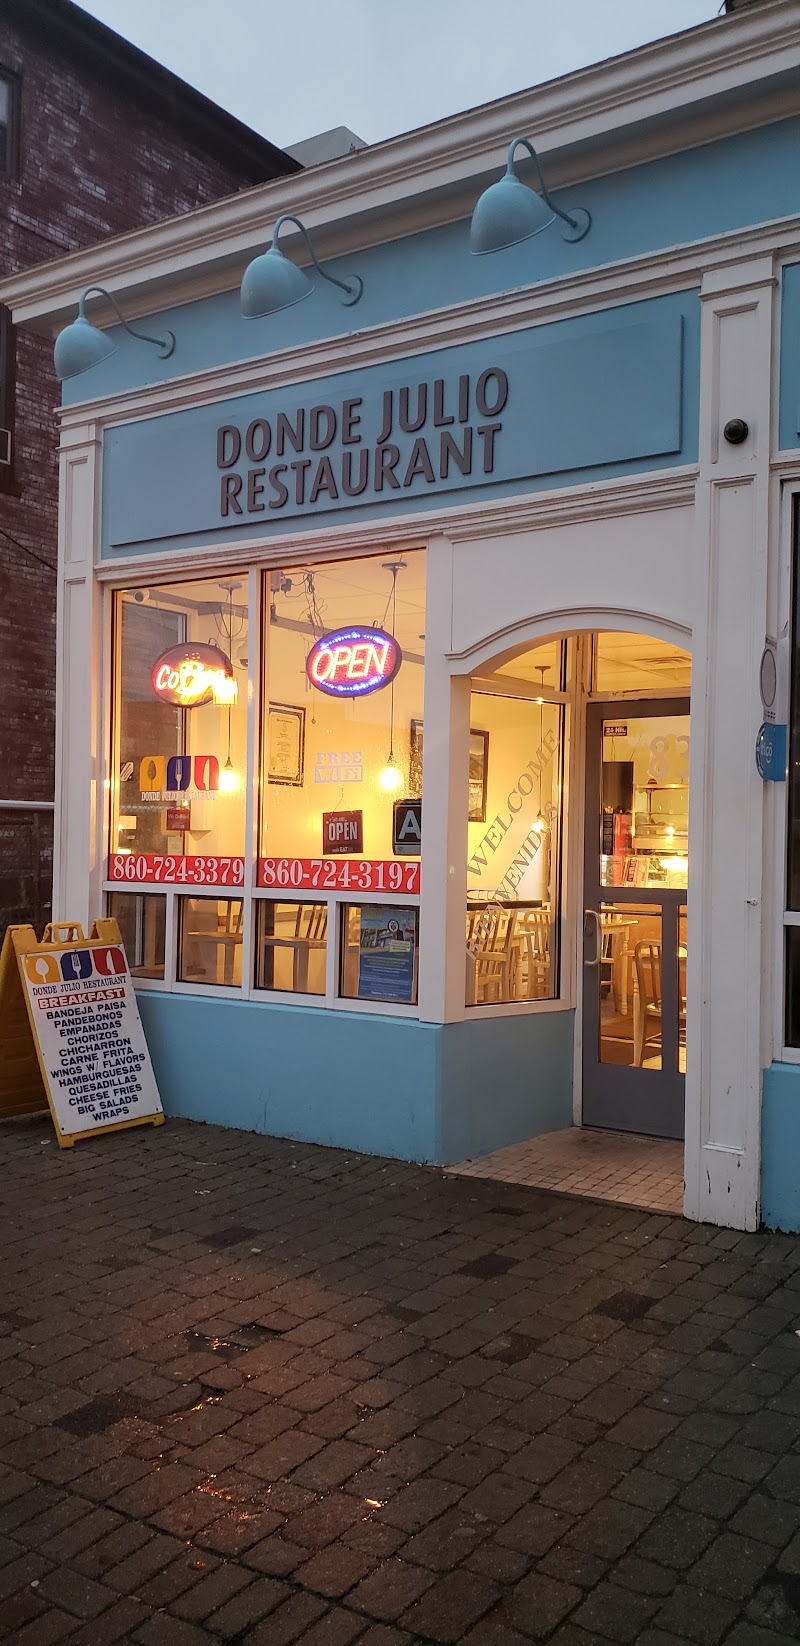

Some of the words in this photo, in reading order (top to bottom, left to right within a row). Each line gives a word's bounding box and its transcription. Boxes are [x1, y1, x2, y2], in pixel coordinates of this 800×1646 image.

[216, 397, 362, 468] DONDE
[376, 367, 509, 444] JULIO
[220, 423, 502, 516] RESTAURANT
[312, 642, 389, 680] OPEN
[317, 752, 362, 764] FREE
[650, 736, 688, 778] 83
[141, 791, 160, 801] DONDE
[467, 728, 560, 878] WELCOME
[328, 821, 358, 841] OPEN
[398, 810, 421, 839] A
[113, 856, 244, 884] 860-724-3379
[263, 859, 418, 890] 860-724-3197
[33, 985, 58, 996] DONDE
[60, 982, 81, 993] JULIO
[83, 976, 127, 991] RESTAURANT
[39, 988, 123, 1009] BREAKFAST
[46, 1006, 94, 1020] BANDEJA
[97, 1001, 127, 1013] PAISA
[54, 1011, 123, 1029] PANDEBONOS
[59, 1020, 122, 1037] EMPANADAS
[67, 1030, 119, 1046] CHORIZOS
[59, 1037, 132, 1057] CHICHARRON
[61, 1053, 99, 1067] CARNE
[102, 1046, 134, 1059] FRITA
[50, 1065, 83, 1079] WINGS
[86, 1061, 99, 1072] W/
[102, 1053, 146, 1069] FLAVORS
[58, 1063, 142, 1088] HAMBURGUESAS
[68, 1074, 138, 1096] QUESADILLAS
[68, 1090, 110, 1107] CHEESE
[113, 1083, 143, 1097] FRIES
[77, 1104, 96, 1115] BIG
[99, 1094, 139, 1110] SALADS
[92, 1106, 130, 1122] WRAPS
